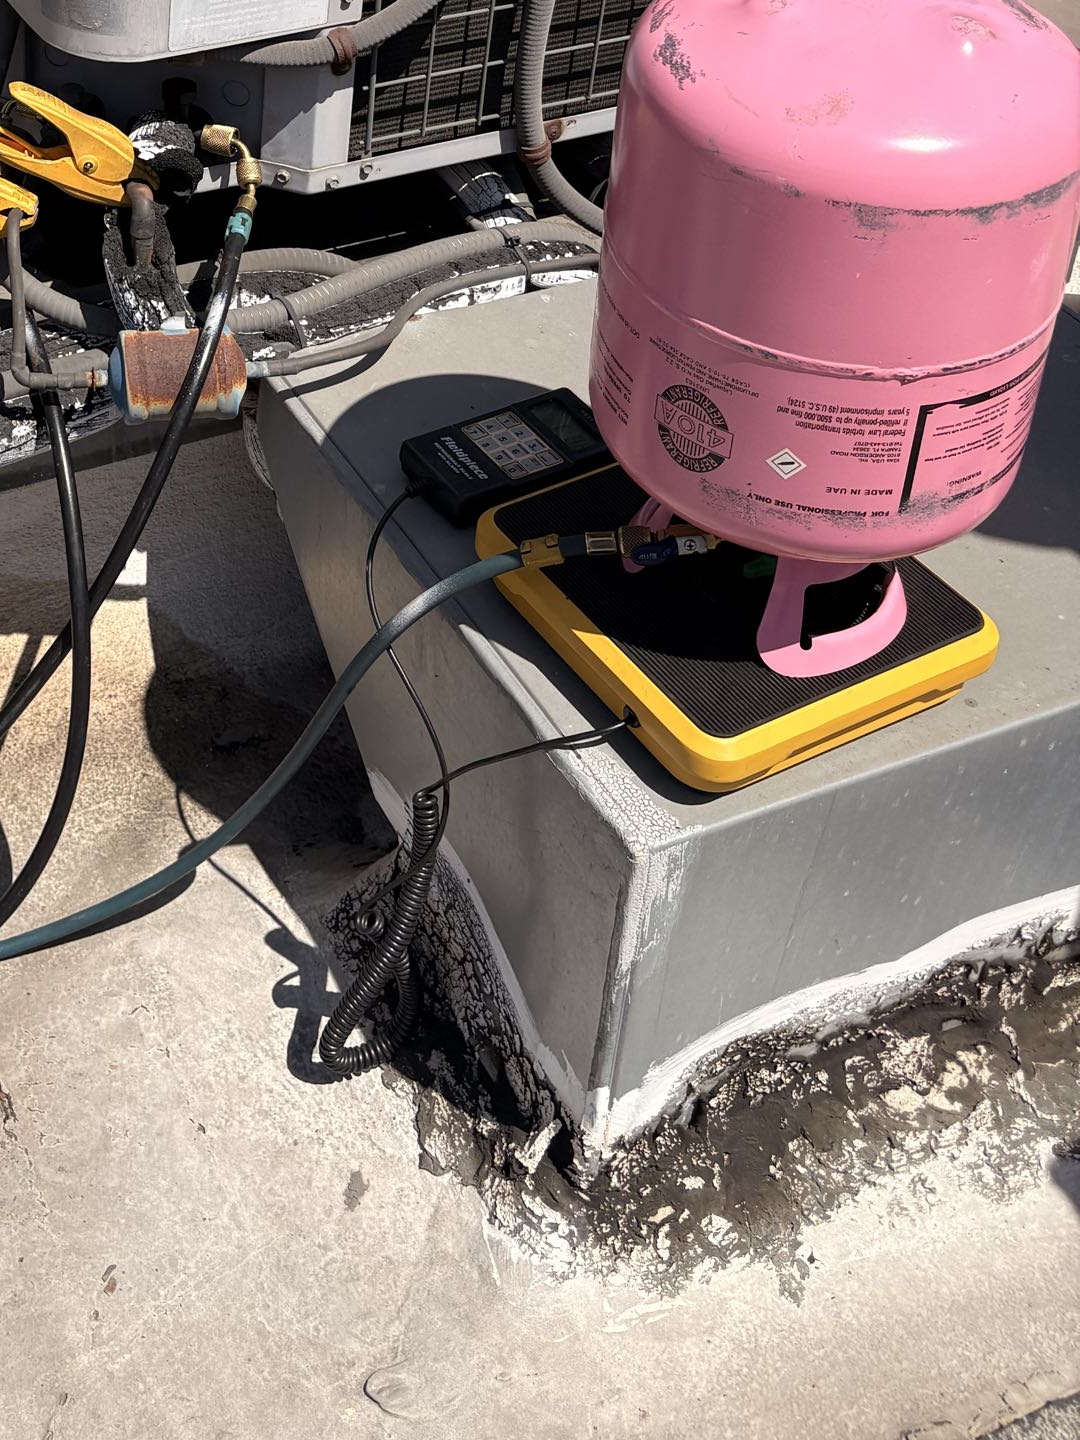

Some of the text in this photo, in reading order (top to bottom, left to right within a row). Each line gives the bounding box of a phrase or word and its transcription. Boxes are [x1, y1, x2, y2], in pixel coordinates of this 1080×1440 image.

[665, 386, 725, 426] REFRIGERANT
[776, 405, 790, 415] and
[786, 396, 910, 417] 5 years imprisonment (49 U.S.C. 5124).
[790, 409, 803, 419] fine
[803, 411, 833, 424] $500,000
[843, 415, 853, 425] up
[660, 399, 726, 448] 410A
[835, 417, 843, 425] to
[853, 417, 901, 428] refilled-penalty
[795, 420, 906, 437] Federal Law forbids transportation
[659, 429, 717, 472] REFRIGERANT
[440, 435, 489, 481] Fieldpiece
[946, 470, 982, 487] WARNING:
[825, 486, 847, 495] UAE
[864, 488, 893, 496] MADE
[746, 492, 772, 504] ONLY
[774, 499, 793, 509] USE
[795, 504, 867, 518] PROFESSIONAL
